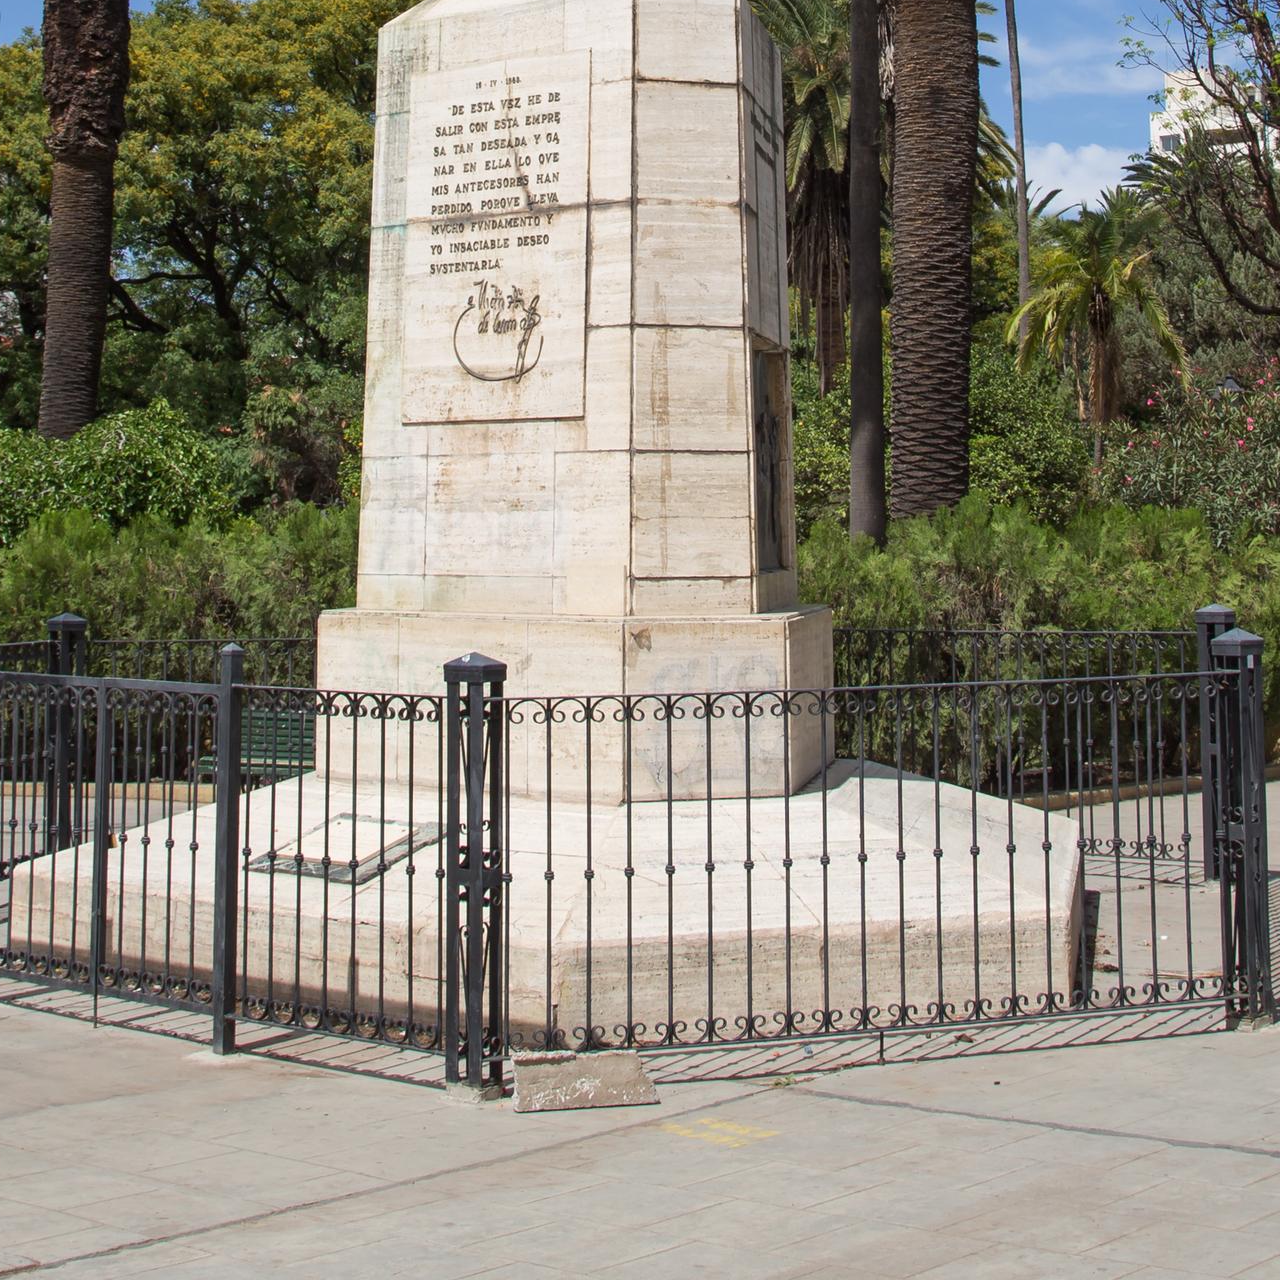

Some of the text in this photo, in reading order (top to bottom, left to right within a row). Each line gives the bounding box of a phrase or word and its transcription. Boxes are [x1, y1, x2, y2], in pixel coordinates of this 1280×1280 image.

[470, 101, 495, 114] ESTA
[527, 94, 542, 106] HE
[548, 91, 561, 103] DE
[434, 125, 464, 138] SALIR
[469, 121, 488, 134] CON
[494, 118, 519, 131] ESTA
[433, 146, 447, 157] SA
[453, 142, 474, 155] TAN
[480, 136, 528, 152] DESEADA
[533, 133, 541, 144] Y
[433, 165, 455, 177] NAR
[463, 161, 477, 173] EN
[484, 158, 512, 171] ELLA
[518, 155, 531, 167] LO
[431, 172, 560, 196] MIS ANTECESORES HAN
[431, 202, 472, 216] PERDIDO
[527, 192, 559, 206] LLEVA
[431, 213, 554, 236] MVCHO FVNDAMENTO Y
[430, 234, 550, 255] YO INSACIABLE DESEO
